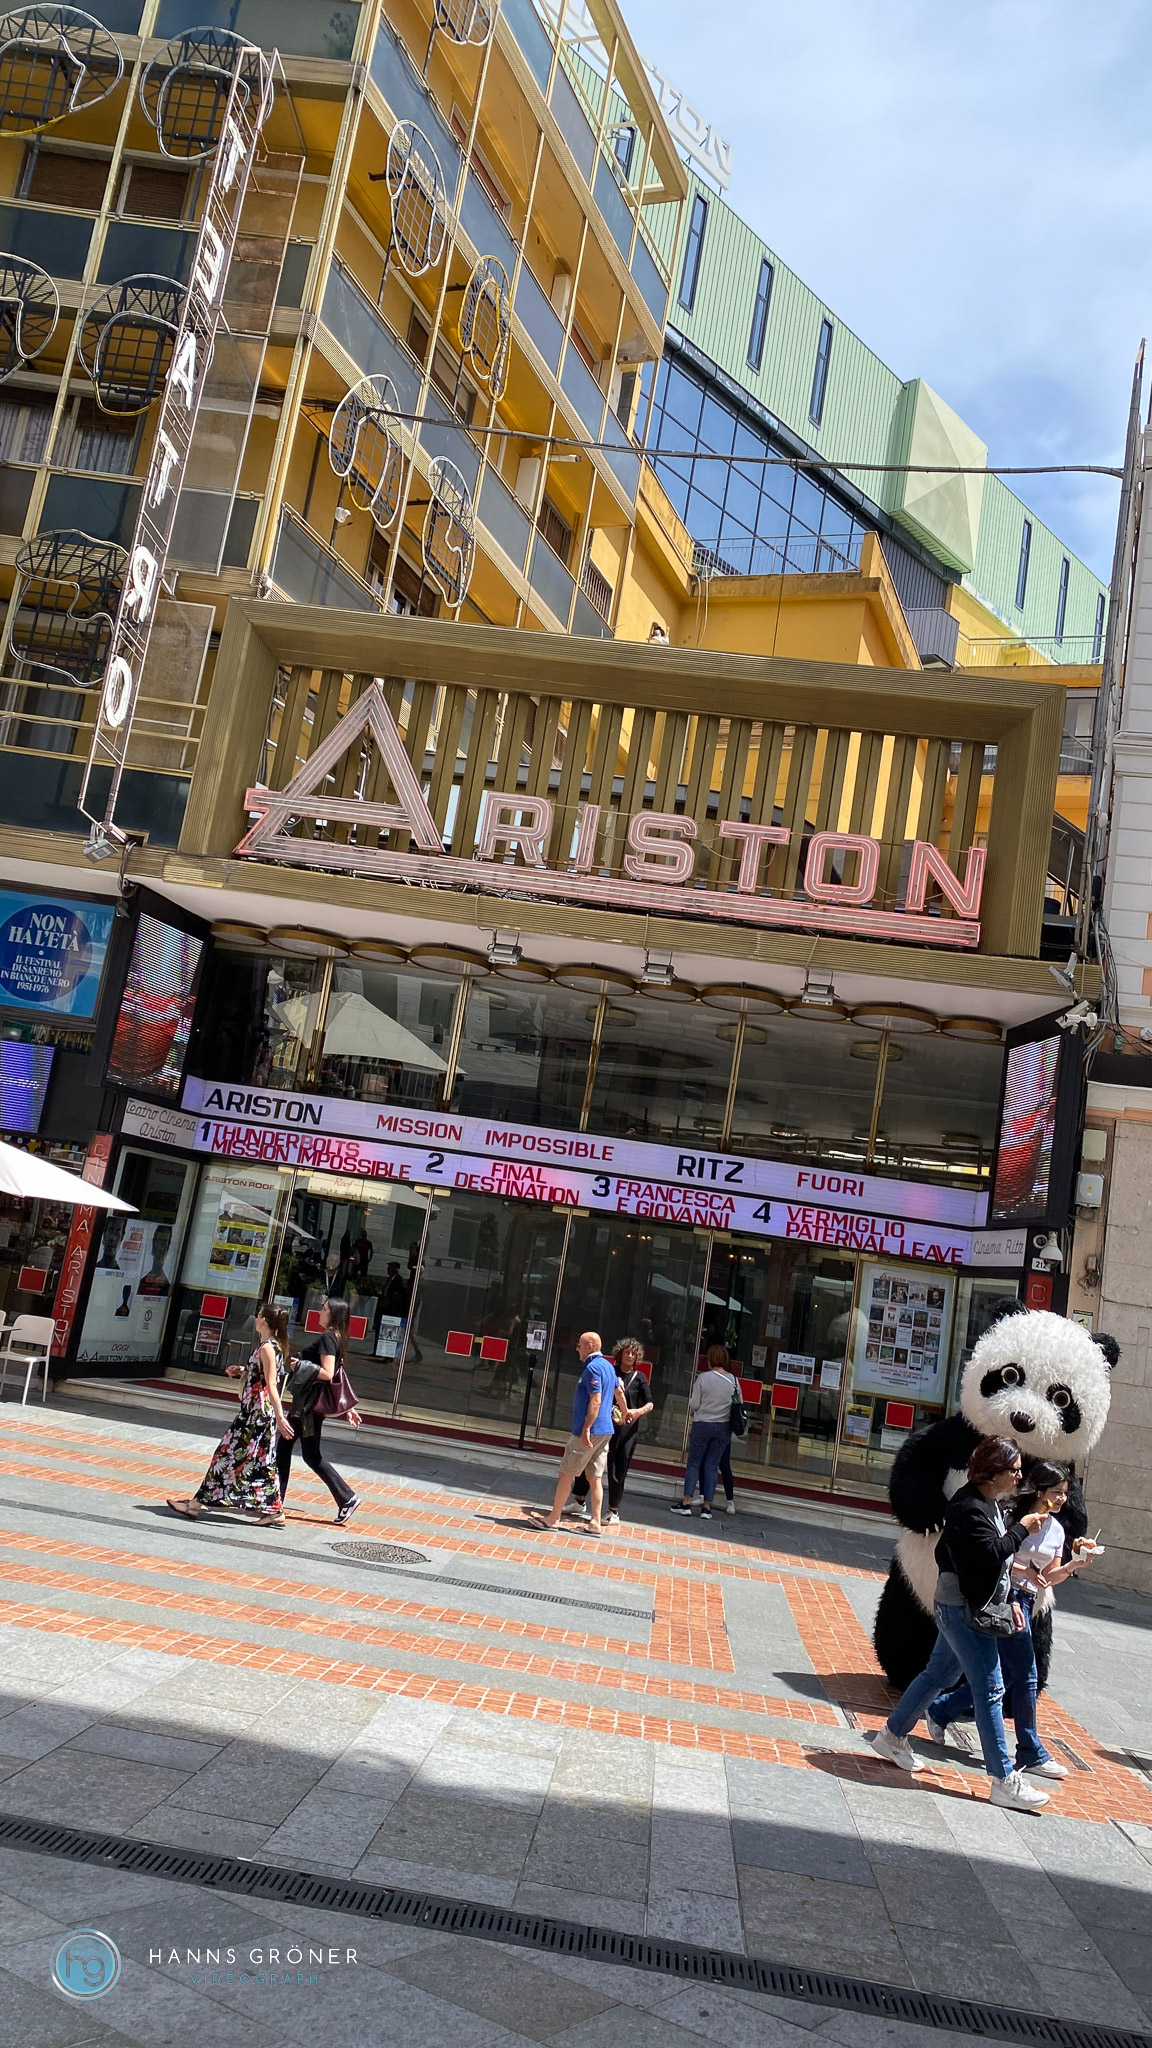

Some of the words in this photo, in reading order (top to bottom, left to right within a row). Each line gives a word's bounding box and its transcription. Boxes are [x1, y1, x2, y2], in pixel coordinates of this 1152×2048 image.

[234, 678, 987, 921] ARISTON
[29, 912, 67, 932] NON
[8, 926, 32, 945] HA
[12, 963, 22, 972] DI
[22, 964, 62, 978] SANREMO
[15, 955, 23, 963] IL
[25, 956, 62, 970] FESTIVAL
[0, 970, 9, 978] IN
[10, 971, 40, 983] BIANCO
[40, 976, 48, 985] E
[48, 977, 70, 988] NERO
[16, 981, 50, 993] 1951-1976
[126, 1100, 158, 1120] Teatro
[159, 1110, 197, 1132] Cinema
[204, 1088, 323, 1125] ARISTON
[200, 1121, 211, 1142] 1
[213, 1123, 360, 1158] THUNDERBOLTS
[377, 1114, 463, 1141] MISSION
[485, 1129, 615, 1162] IMPOSSIBLE
[211, 1137, 290, 1162] MISSION
[297, 1146, 412, 1181] IMPOSSIBLE
[425, 1152, 445, 1174] 2
[676, 1154, 745, 1184] RITZ
[204, 1175, 248, 1188] ARISTON
[333, 1177, 354, 1191] Roof
[491, 1162, 547, 1184] FINAL
[797, 1171, 865, 1197] FUORI
[76, 1143, 106, 1234] CINMA
[454, 1172, 580, 1206] DESTINATION
[592, 1175, 611, 1198] 3
[615, 1179, 736, 1213] FRANCESCA
[616, 1196, 630, 1214] E
[635, 1200, 730, 1229] GIOVANNI
[752, 1202, 771, 1223] 4
[787, 1205, 905, 1238] VERMIGLIO
[785, 1221, 891, 1255] PATERNAL
[899, 1239, 964, 1265] LEAVE
[974, 1240, 1002, 1255] Cinema
[1005, 1239, 1024, 1255] Ritz
[53, 1245, 85, 1346] ARISTON
